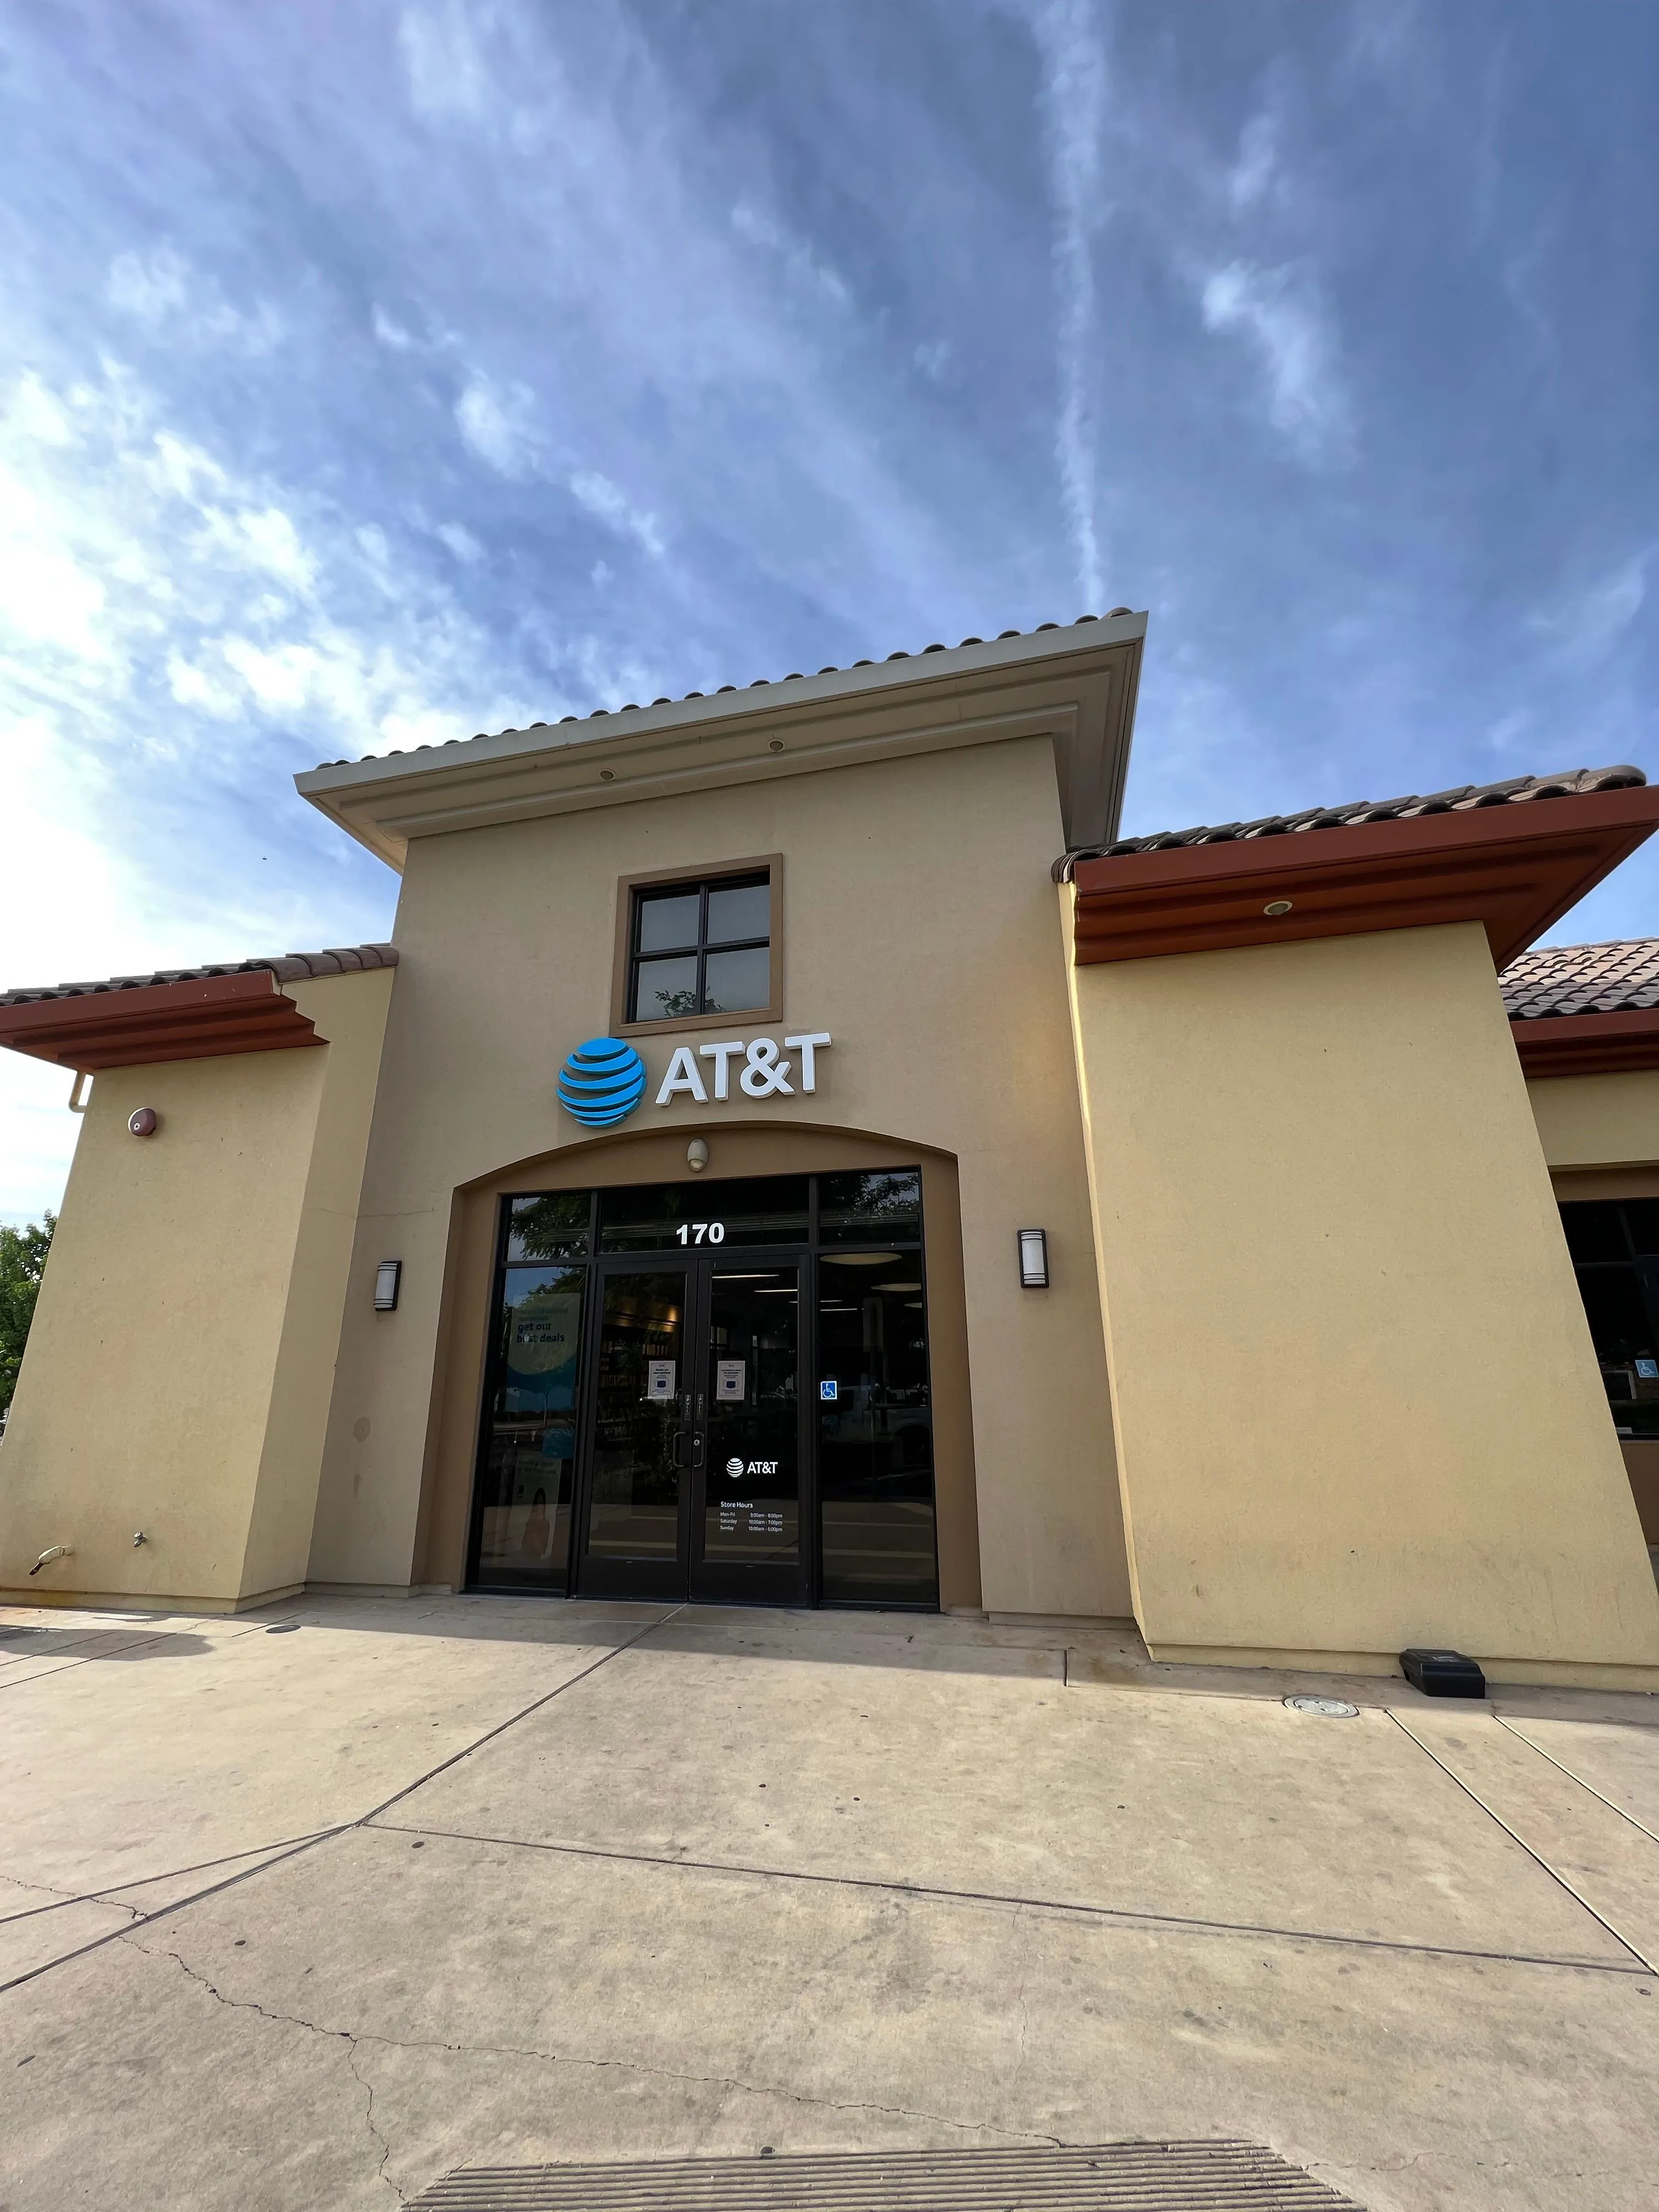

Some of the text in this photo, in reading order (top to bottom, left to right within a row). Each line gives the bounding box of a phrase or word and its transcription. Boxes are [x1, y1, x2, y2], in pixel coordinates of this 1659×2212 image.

[655, 1032, 832, 1106] AT&T
[676, 1223, 724, 1245] 170
[518, 1323, 533, 1333] get
[540, 1333, 565, 1342] deals
[747, 1462, 778, 1474] AT&T
